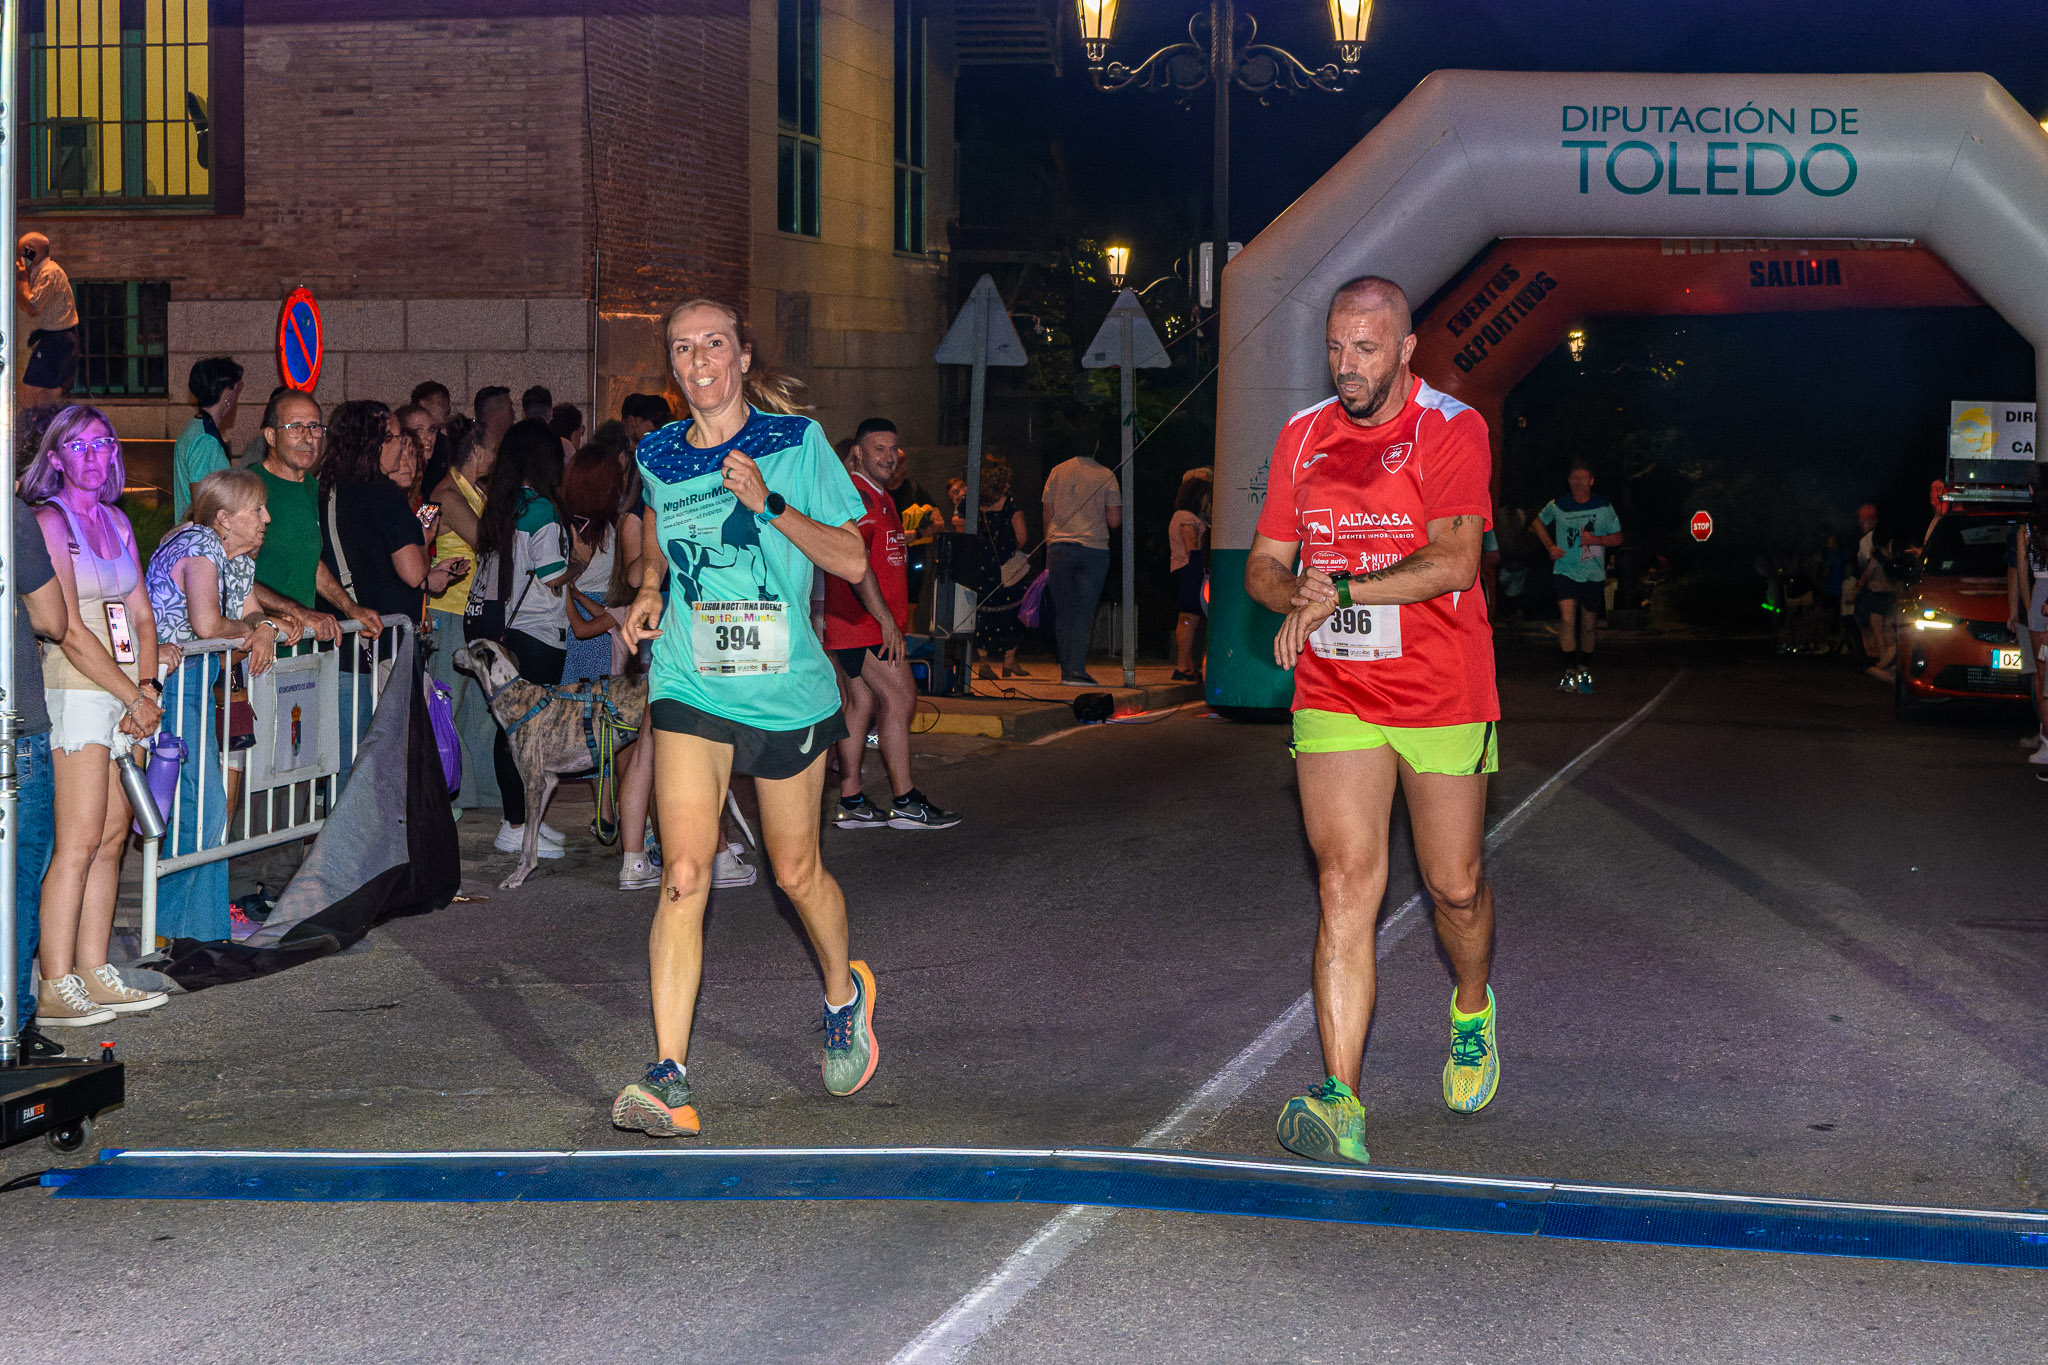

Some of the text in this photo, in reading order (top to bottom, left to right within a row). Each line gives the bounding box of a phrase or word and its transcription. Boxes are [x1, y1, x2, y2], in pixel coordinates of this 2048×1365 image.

[1562, 101, 1859, 135] DIPUTACIÓN DE
[1561, 140, 1858, 197] TOLEDO
[1749, 258, 1842, 288] SALIDA
[1446, 263, 1520, 338] EVENTOS
[1453, 271, 1558, 373] DEPORTIVOS
[663, 485, 732, 513] NightRunMu
[1338, 512, 1413, 527] ALTACASA
[1693, 522, 1710, 531] STOP
[1371, 553, 1402, 563] NUTRI
[702, 602, 720, 611] LEGUA
[721, 602, 759, 611] NOCTURNA
[760, 602, 782, 612] UGENA
[1330, 608, 1372, 635] 396
[716, 625, 761, 651] 394
